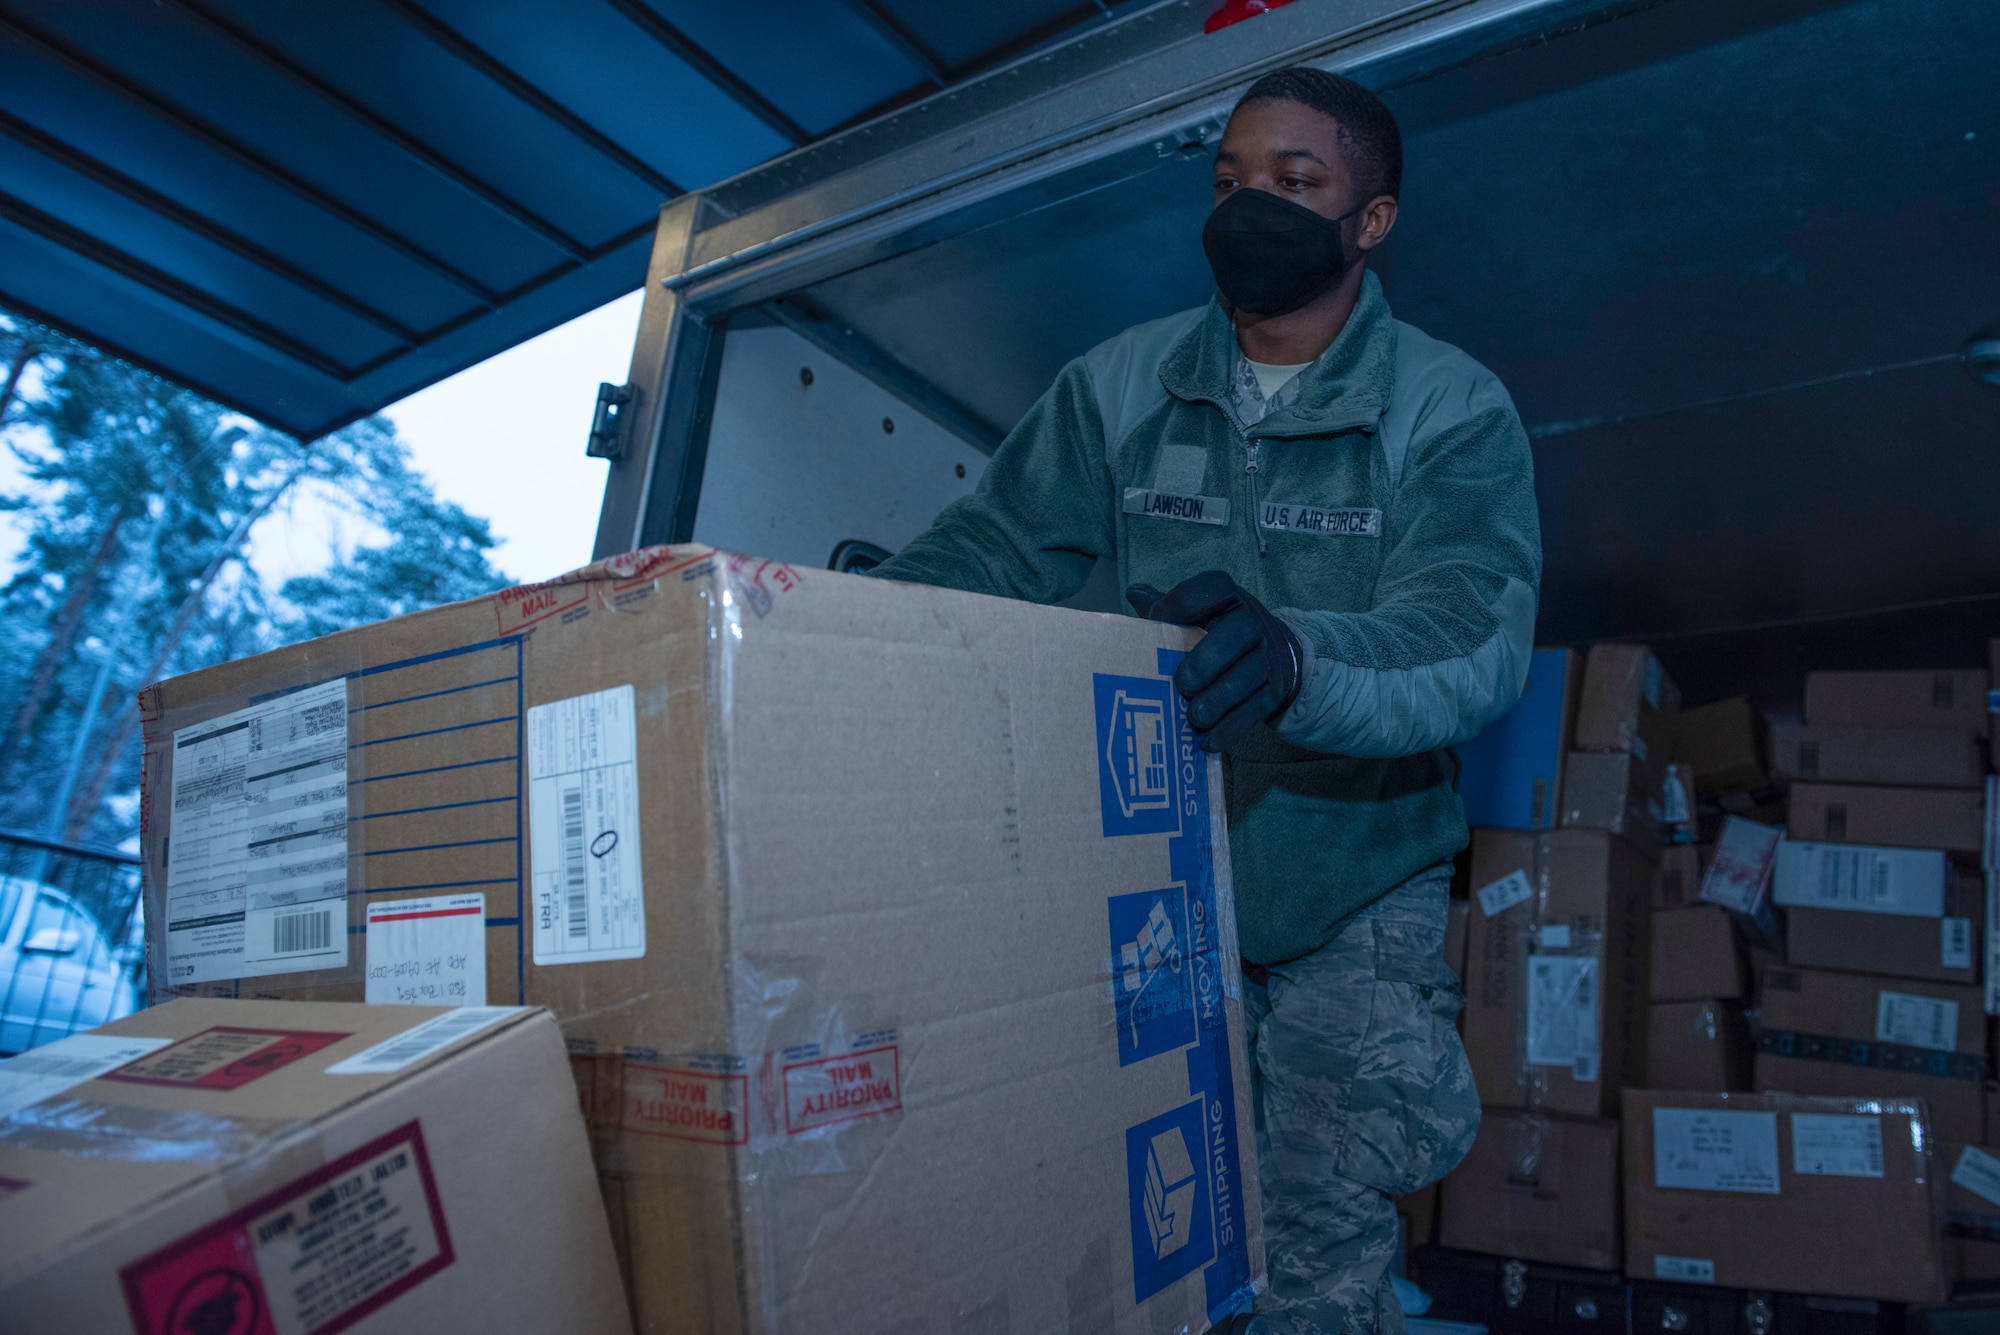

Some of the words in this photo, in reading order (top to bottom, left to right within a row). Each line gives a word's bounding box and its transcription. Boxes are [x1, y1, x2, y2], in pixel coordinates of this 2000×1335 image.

[1143, 492, 1204, 519] LAWSON
[1265, 505, 1290, 527] U.S.
[1296, 509, 1323, 531] AIR
[1326, 510, 1368, 532] FORCE
[522, 590, 557, 618] MAIL
[539, 892, 551, 930] FRA
[1192, 898, 1213, 1021] MOVING
[831, 1060, 873, 1085] MAIL
[658, 1078, 708, 1104] MAIL
[803, 1078, 891, 1114] PRIORITY
[634, 1100, 734, 1132] PRIORITY
[1210, 1097, 1234, 1248] SHIPPING
